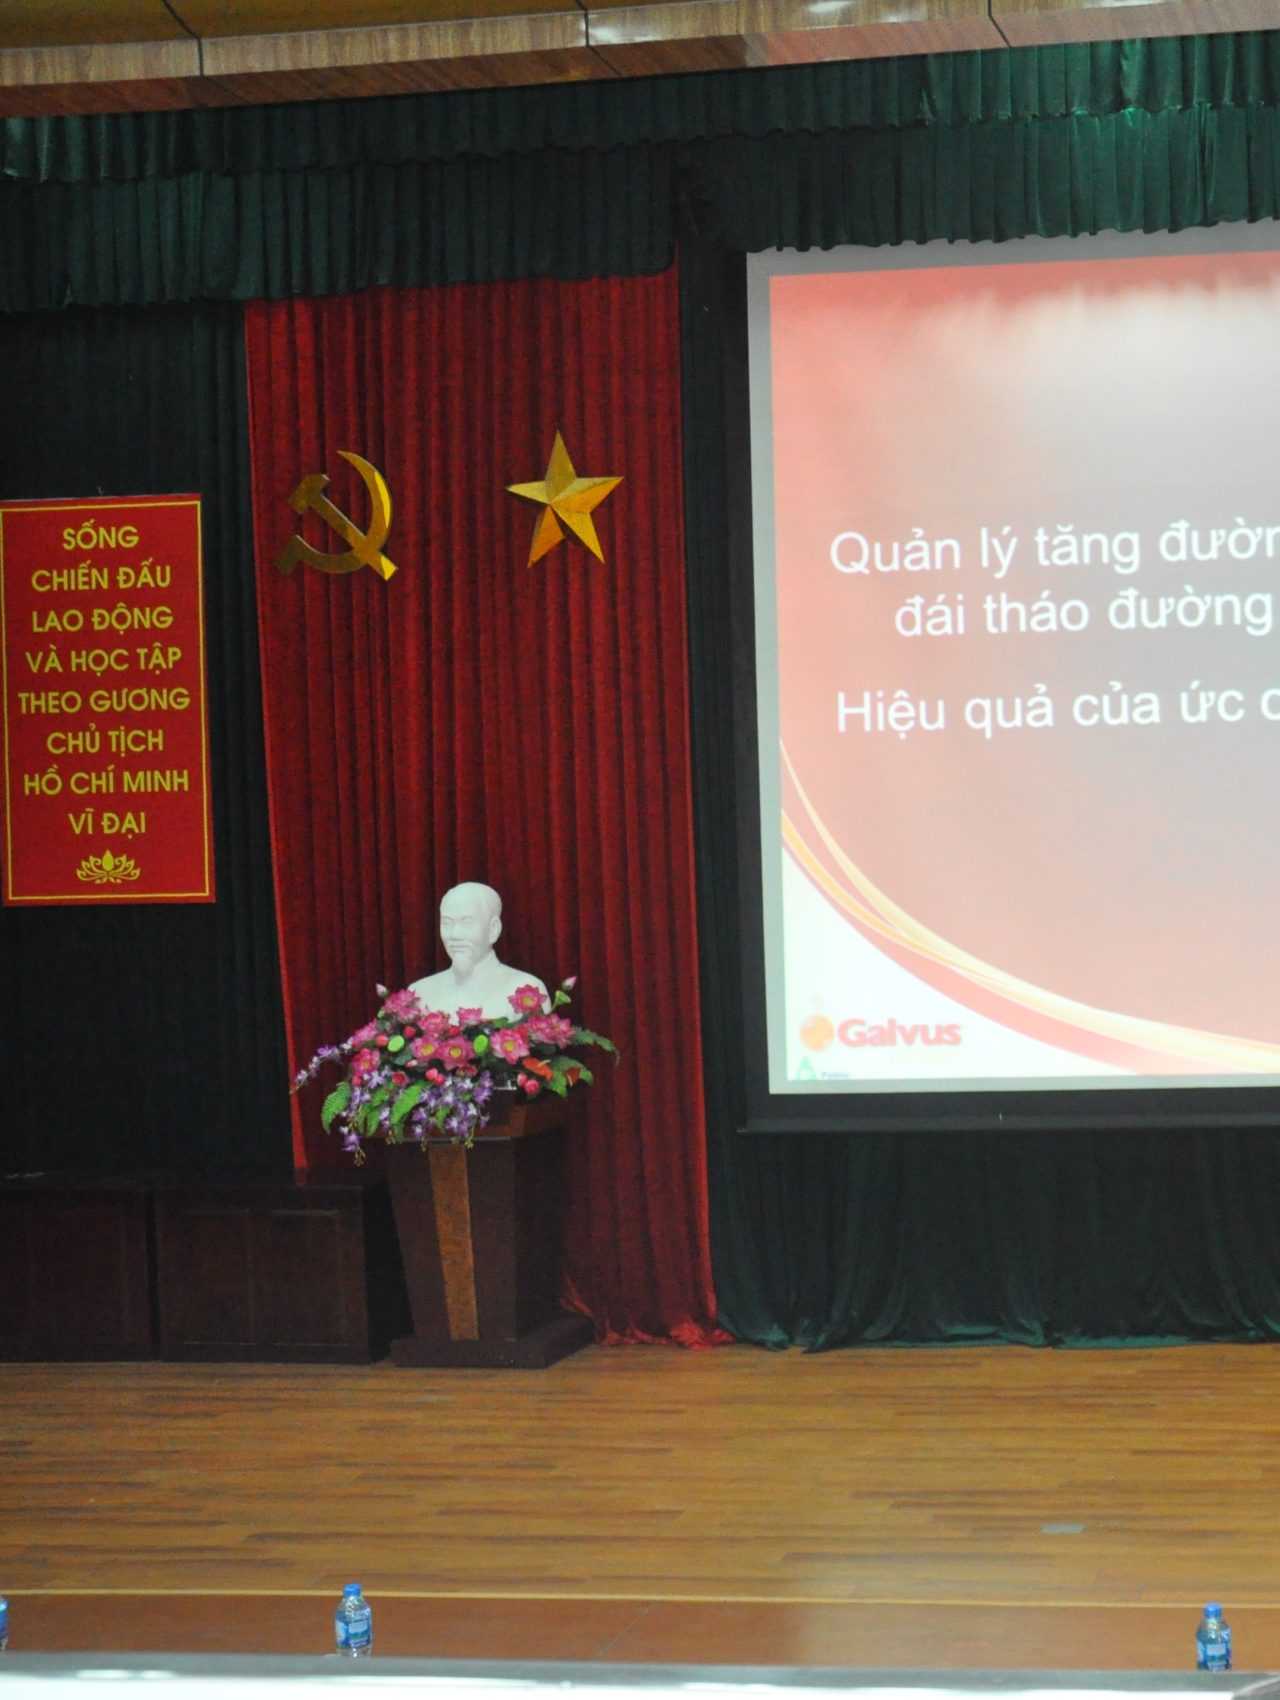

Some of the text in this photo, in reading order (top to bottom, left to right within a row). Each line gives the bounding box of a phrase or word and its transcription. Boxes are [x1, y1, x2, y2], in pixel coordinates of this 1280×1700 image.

[62, 519, 139, 550] SỐNG
[830, 527, 961, 574] Quản
[980, 525, 1018, 578] lý
[1034, 524, 1140, 574] tăng
[32, 557, 171, 592] CHIẾN ĐẤU
[32, 602, 173, 635] LAO ĐỘNG
[894, 594, 965, 637] đái
[984, 590, 1089, 633] tháo
[1108, 584, 1272, 636] đường
[26, 642, 182, 677] VÀ HỌC TẬP
[19, 687, 190, 714] THEO GƯƠNG
[837, 689, 945, 739] Hiệu
[964, 683, 1054, 739] quả
[1072, 681, 1160, 726] của
[1180, 681, 1244, 723] ức
[46, 723, 164, 757] CHỦ TỊCH
[23, 764, 189, 796] HỒ CHÍ MINH
[68, 809, 146, 840] VĨ ĐẠI
[838, 1018, 961, 1047] Galvus
